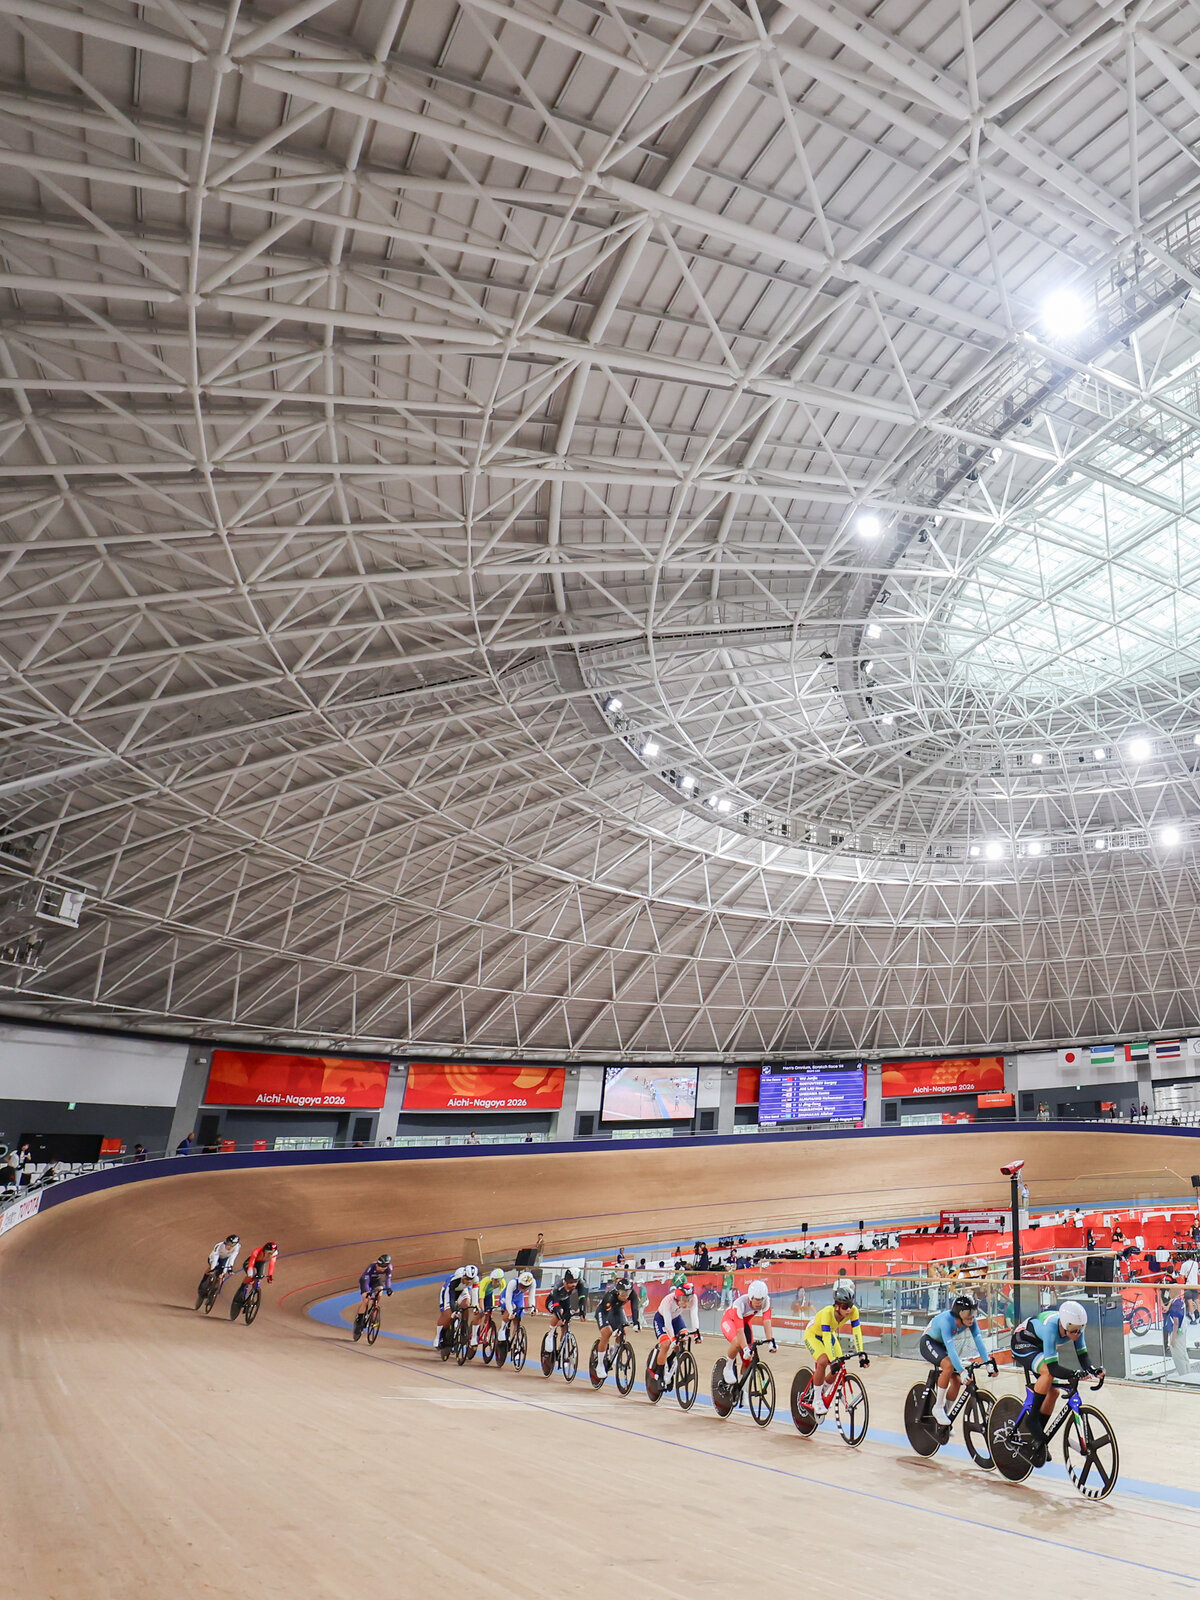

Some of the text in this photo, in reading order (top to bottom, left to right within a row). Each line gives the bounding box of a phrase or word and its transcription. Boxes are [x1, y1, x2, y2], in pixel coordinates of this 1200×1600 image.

[913, 1085, 957, 1094] Aichi-Nagoya
[256, 1093, 346, 1106] Aichi-Nagoya 2026
[447, 1098, 506, 1109] Aichi-Nagoya
